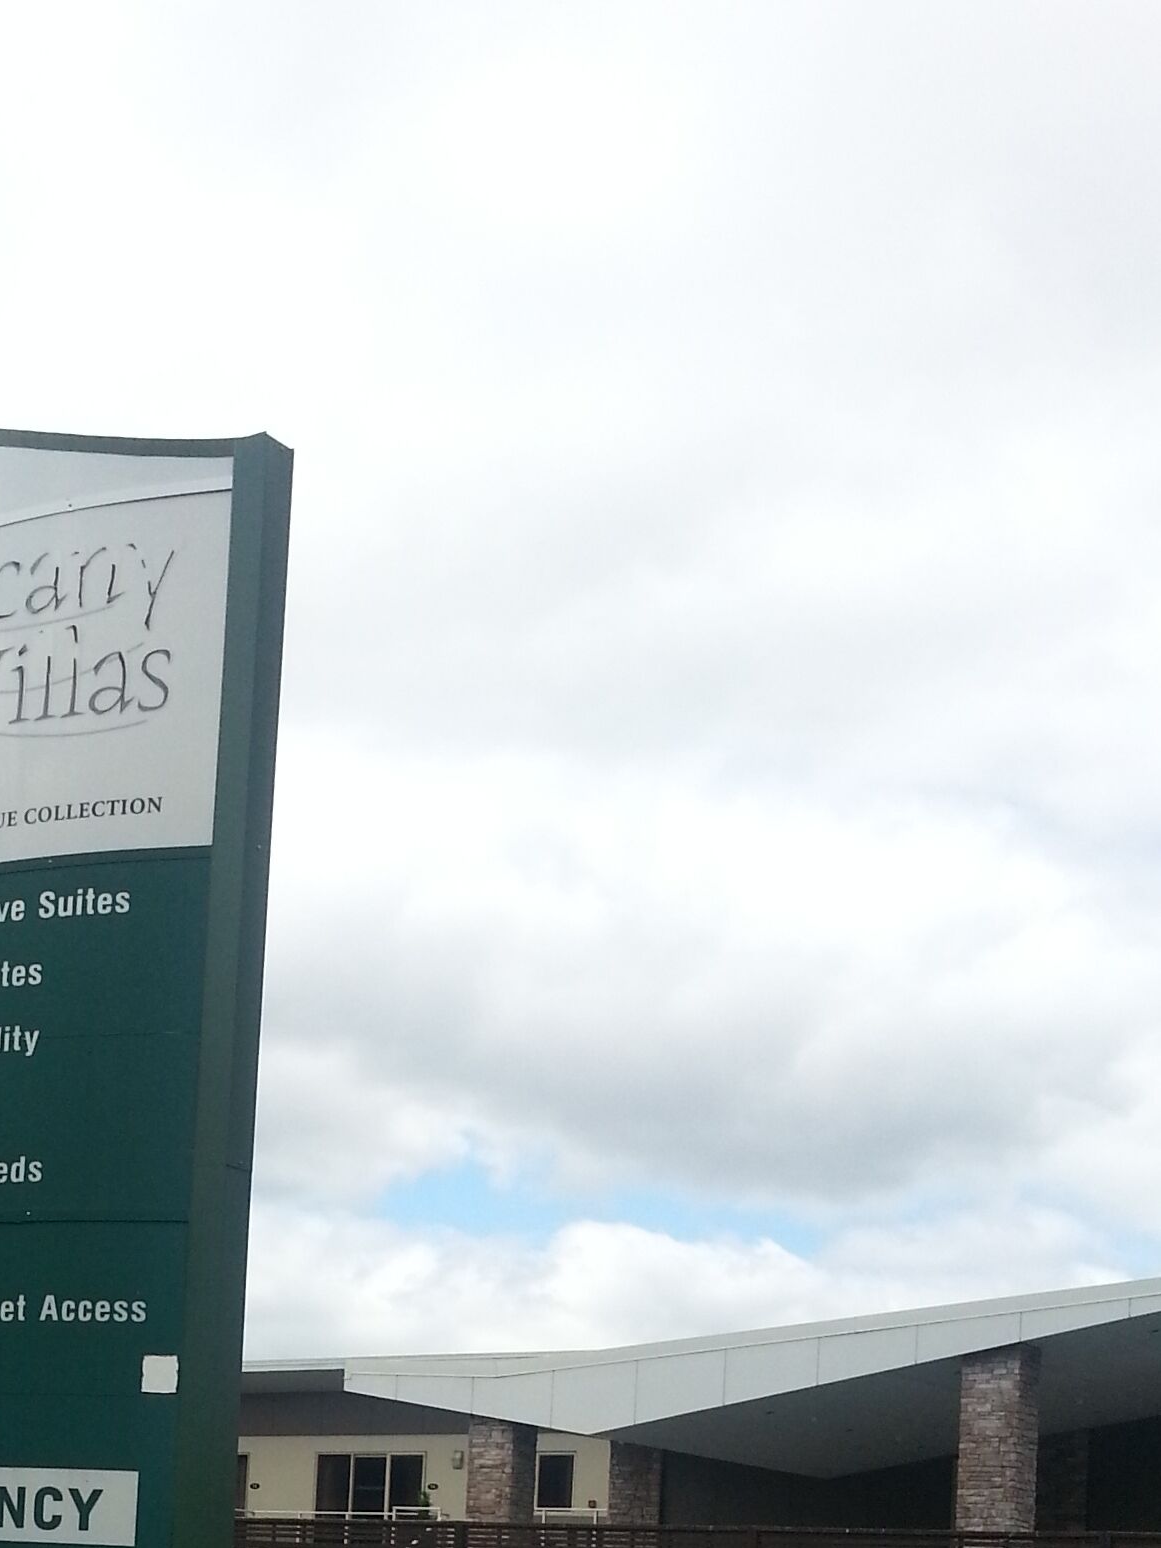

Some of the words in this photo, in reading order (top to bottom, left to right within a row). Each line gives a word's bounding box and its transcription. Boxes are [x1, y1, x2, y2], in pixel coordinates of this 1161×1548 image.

[24, 797, 163, 826] COLLECTION
[38, 888, 131, 919] Suites
[39, 1294, 147, 1323] Access
